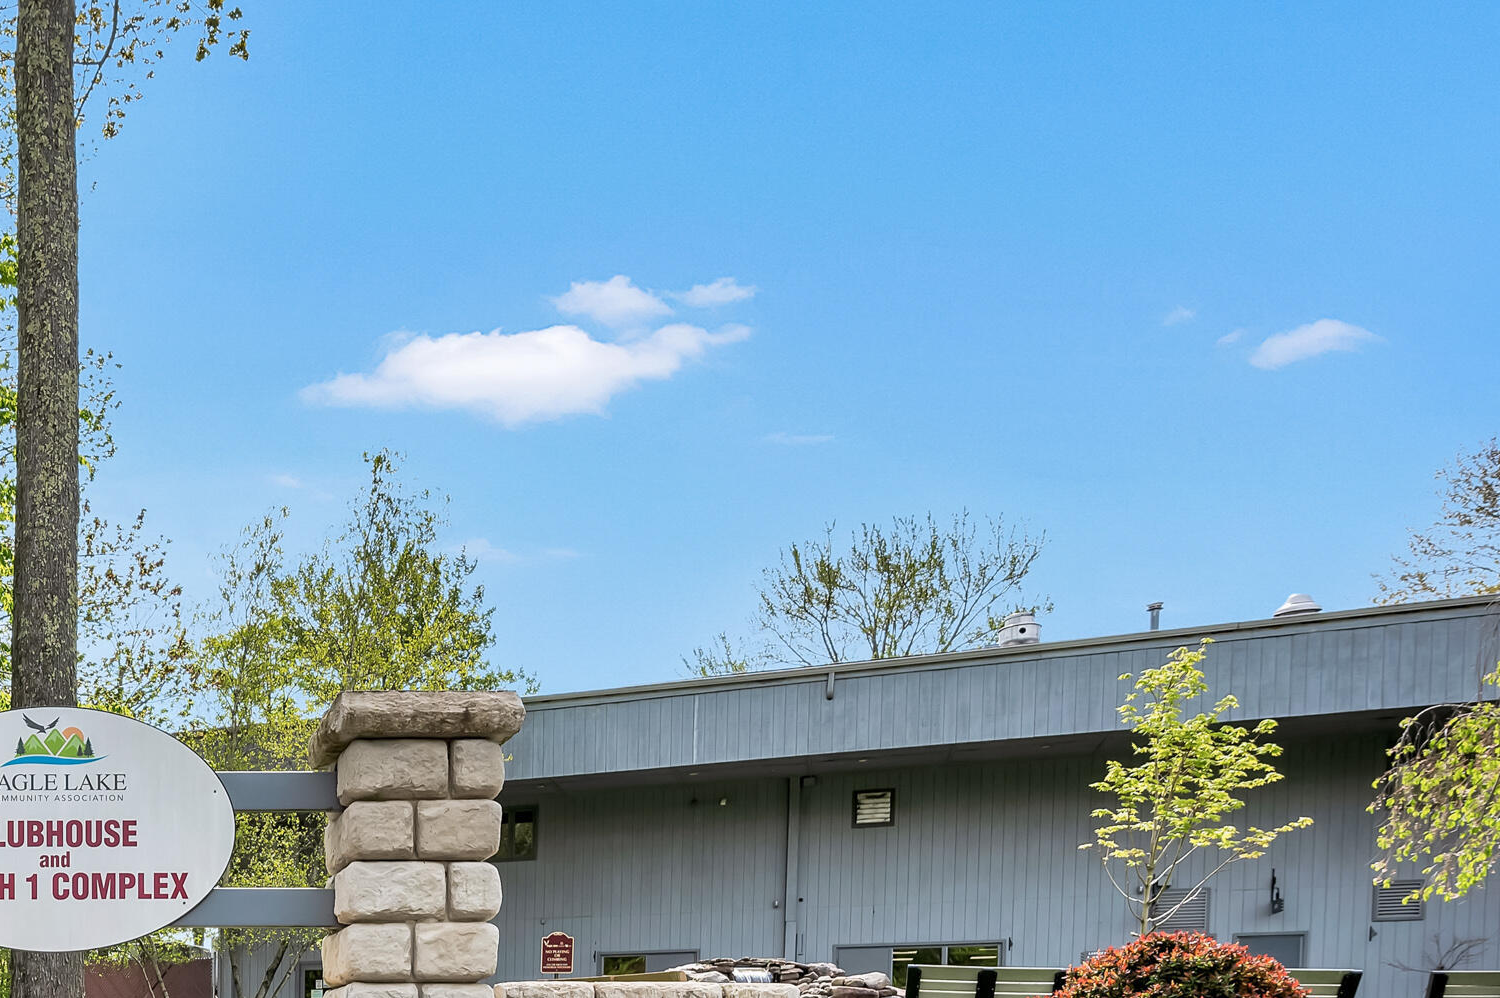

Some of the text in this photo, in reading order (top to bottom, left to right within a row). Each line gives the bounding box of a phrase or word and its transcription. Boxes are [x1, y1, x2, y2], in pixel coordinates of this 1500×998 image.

[64, 773, 127, 791] LAKE
[54, 794, 124, 802] ASSOCIATION
[39, 851, 71, 868] and
[25, 872, 38, 900] 1
[52, 872, 189, 900] COMPLEX
